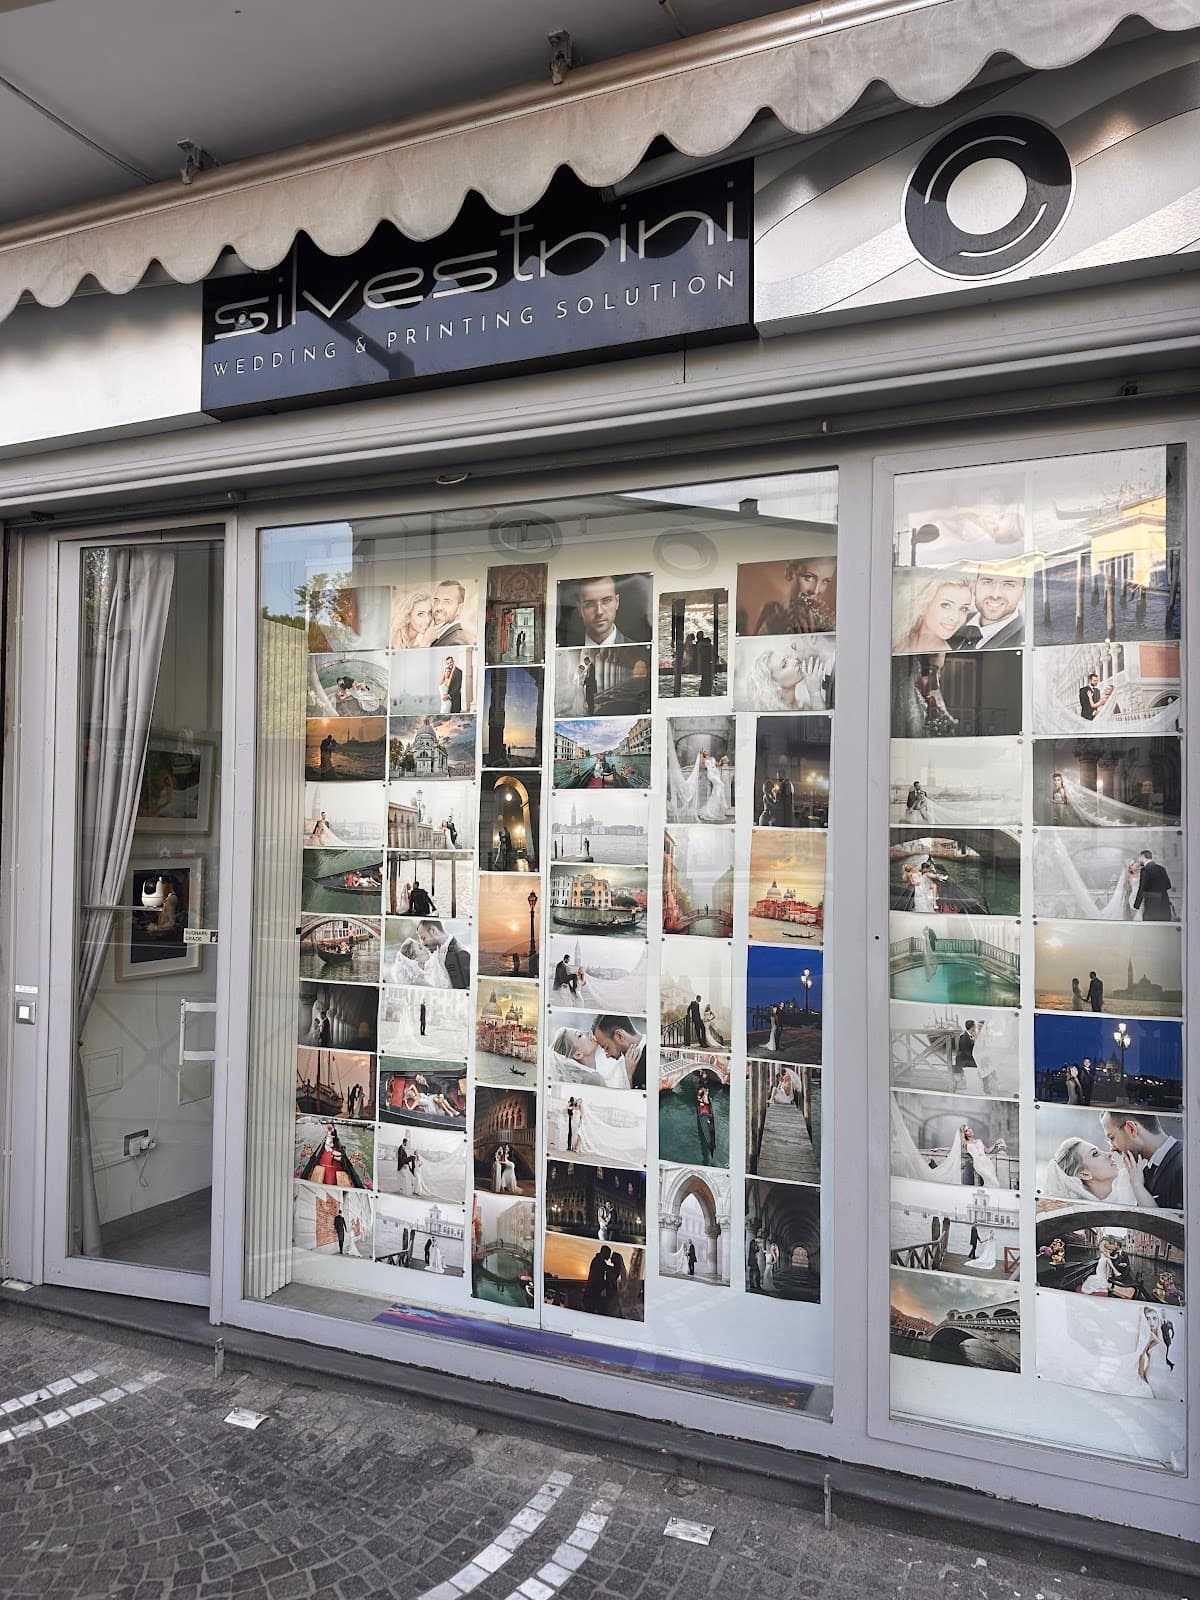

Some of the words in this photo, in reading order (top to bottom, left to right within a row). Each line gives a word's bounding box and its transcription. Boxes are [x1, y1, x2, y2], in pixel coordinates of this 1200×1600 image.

[214, 180, 735, 340] silvestrini
[214, 342, 337, 377] WEDDING
[355, 335, 367, 354] &
[387, 307, 533, 348] PRINTING
[556, 270, 735, 319] SOLUTION
